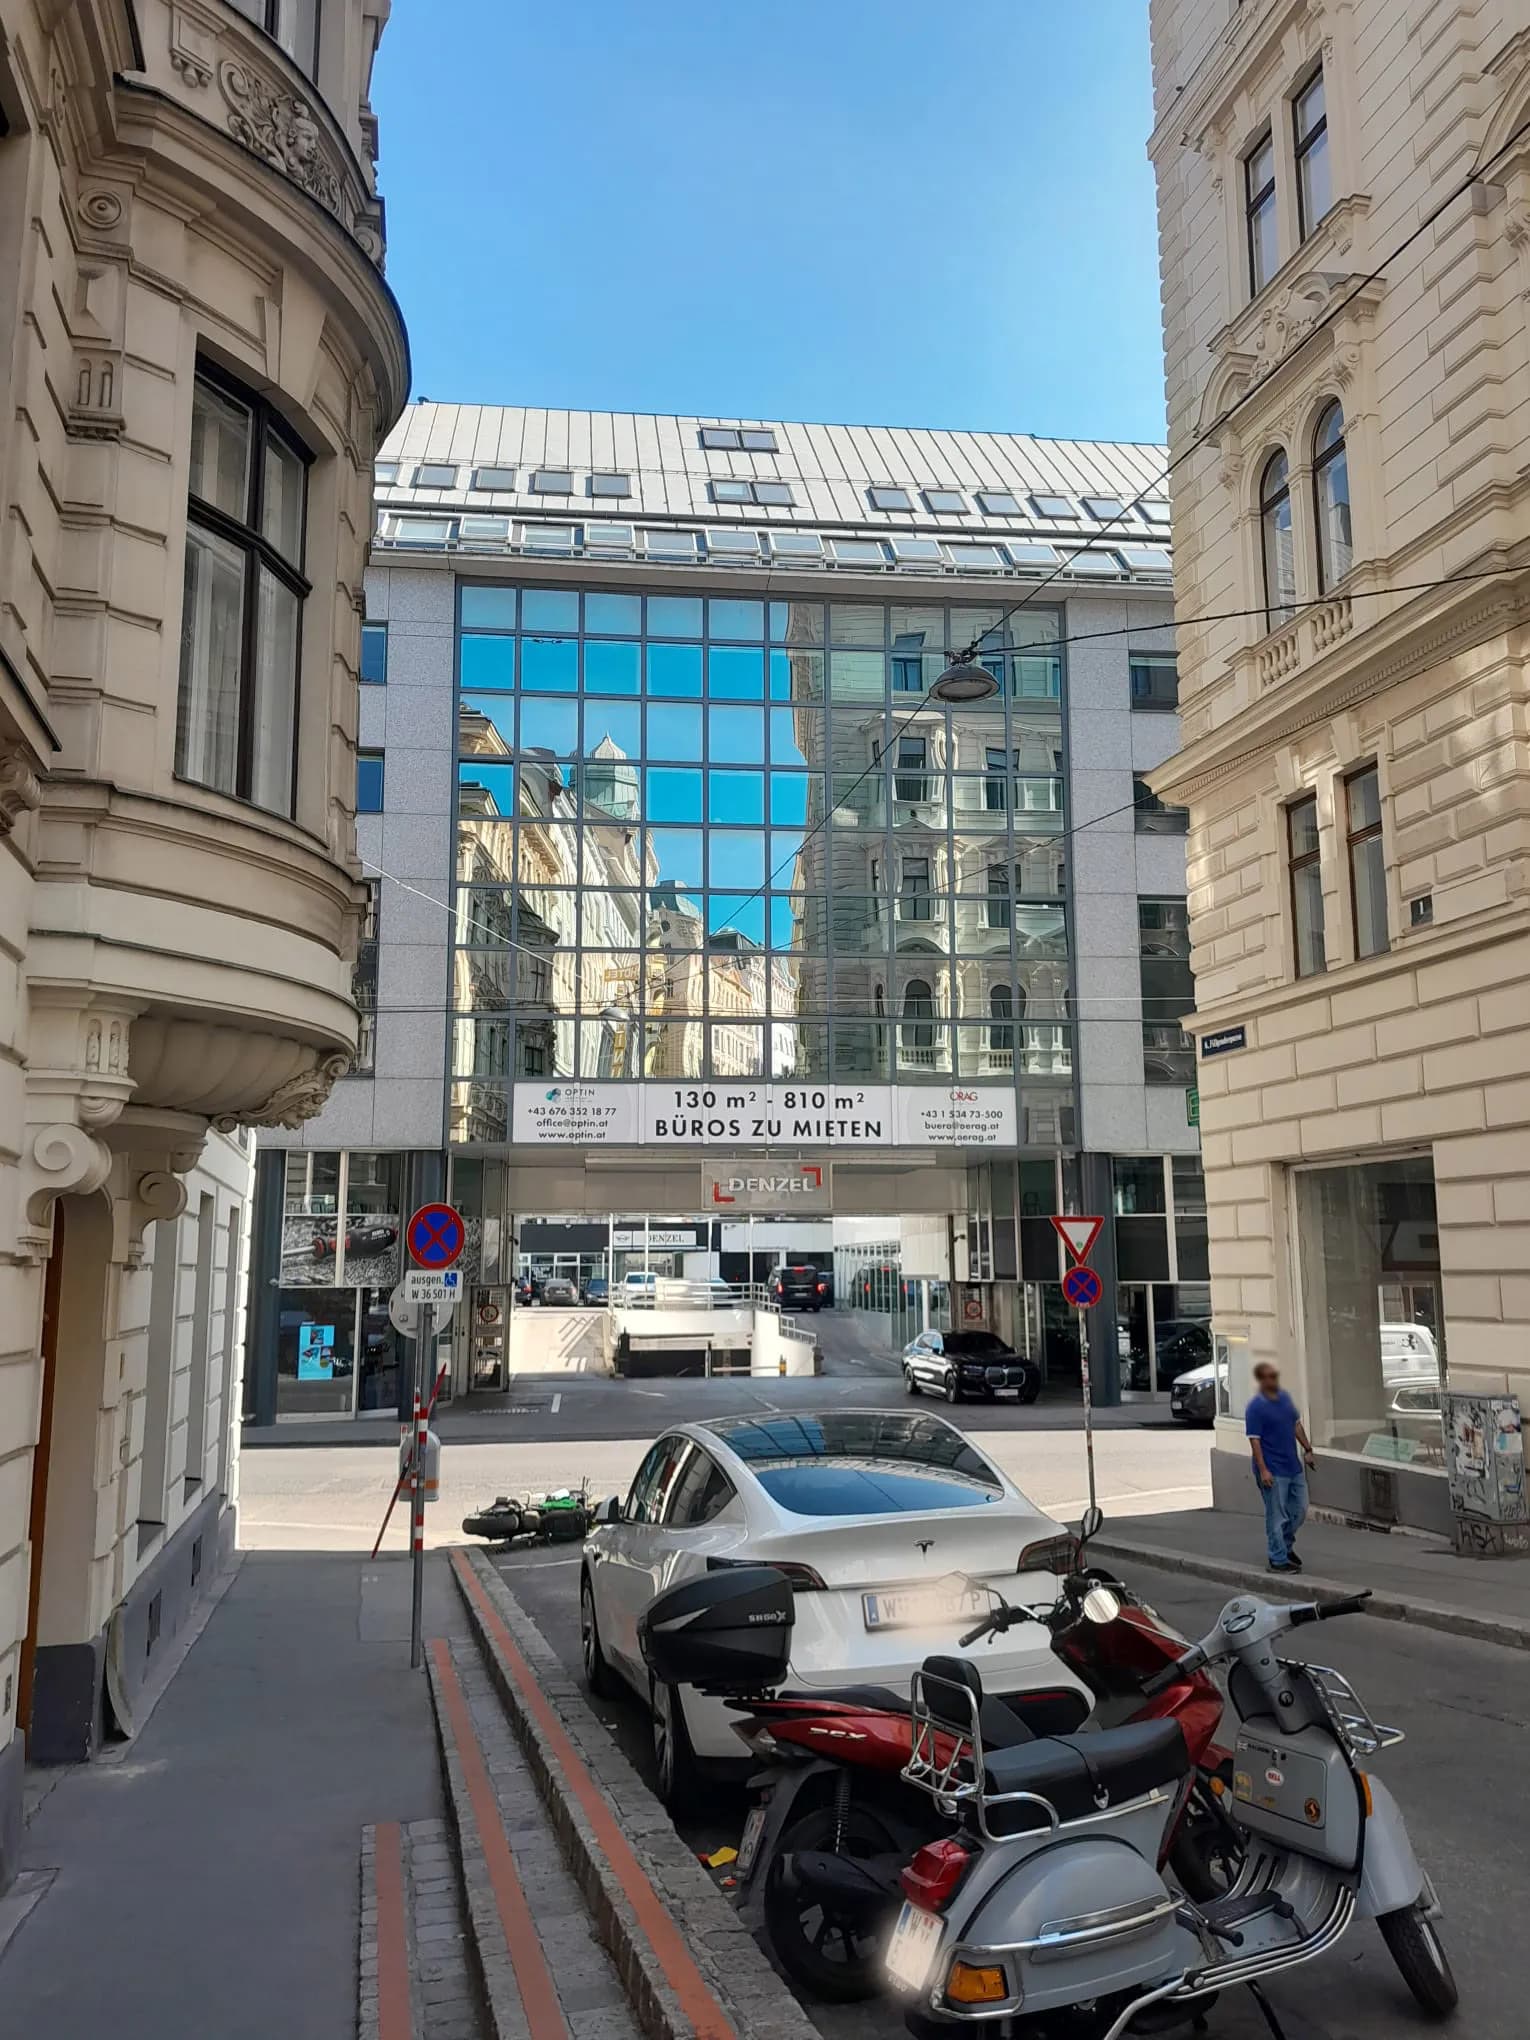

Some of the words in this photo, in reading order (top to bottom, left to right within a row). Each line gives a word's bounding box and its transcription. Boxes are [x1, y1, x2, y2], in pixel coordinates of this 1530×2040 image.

[1419, 901, 1424, 915] 1
[565, 1089, 595, 1097] OPTIN
[674, 1091, 716, 1108] 130
[784, 1092, 825, 1109] 810
[528, 1107, 546, 1116] +43
[549, 1107, 567, 1116] 676
[569, 1107, 588, 1116] 352
[591, 1107, 602, 1116] 18
[605, 1107, 617, 1116] 77
[921, 1110, 937, 1118] +43
[949, 1110, 966, 1118] 534
[969, 1110, 1003, 1118] 73-500
[536, 1119, 608, 1131] office@optin.at
[655, 1114, 741, 1137] BÜROS
[751, 1120, 781, 1137] ZU
[793, 1120, 882, 1138] MIETEN
[538, 1131, 606, 1142] www.optin.at
[928, 1133, 996, 1143] www.oerag.at
[728, 1177, 814, 1192] DENZEL
[411, 1276, 444, 1287] ausgen.
[411, 1289, 419, 1299] W
[421, 1288, 431, 1299] 36
[433, 1288, 446, 1299] 501
[449, 1289, 456, 1299] H
